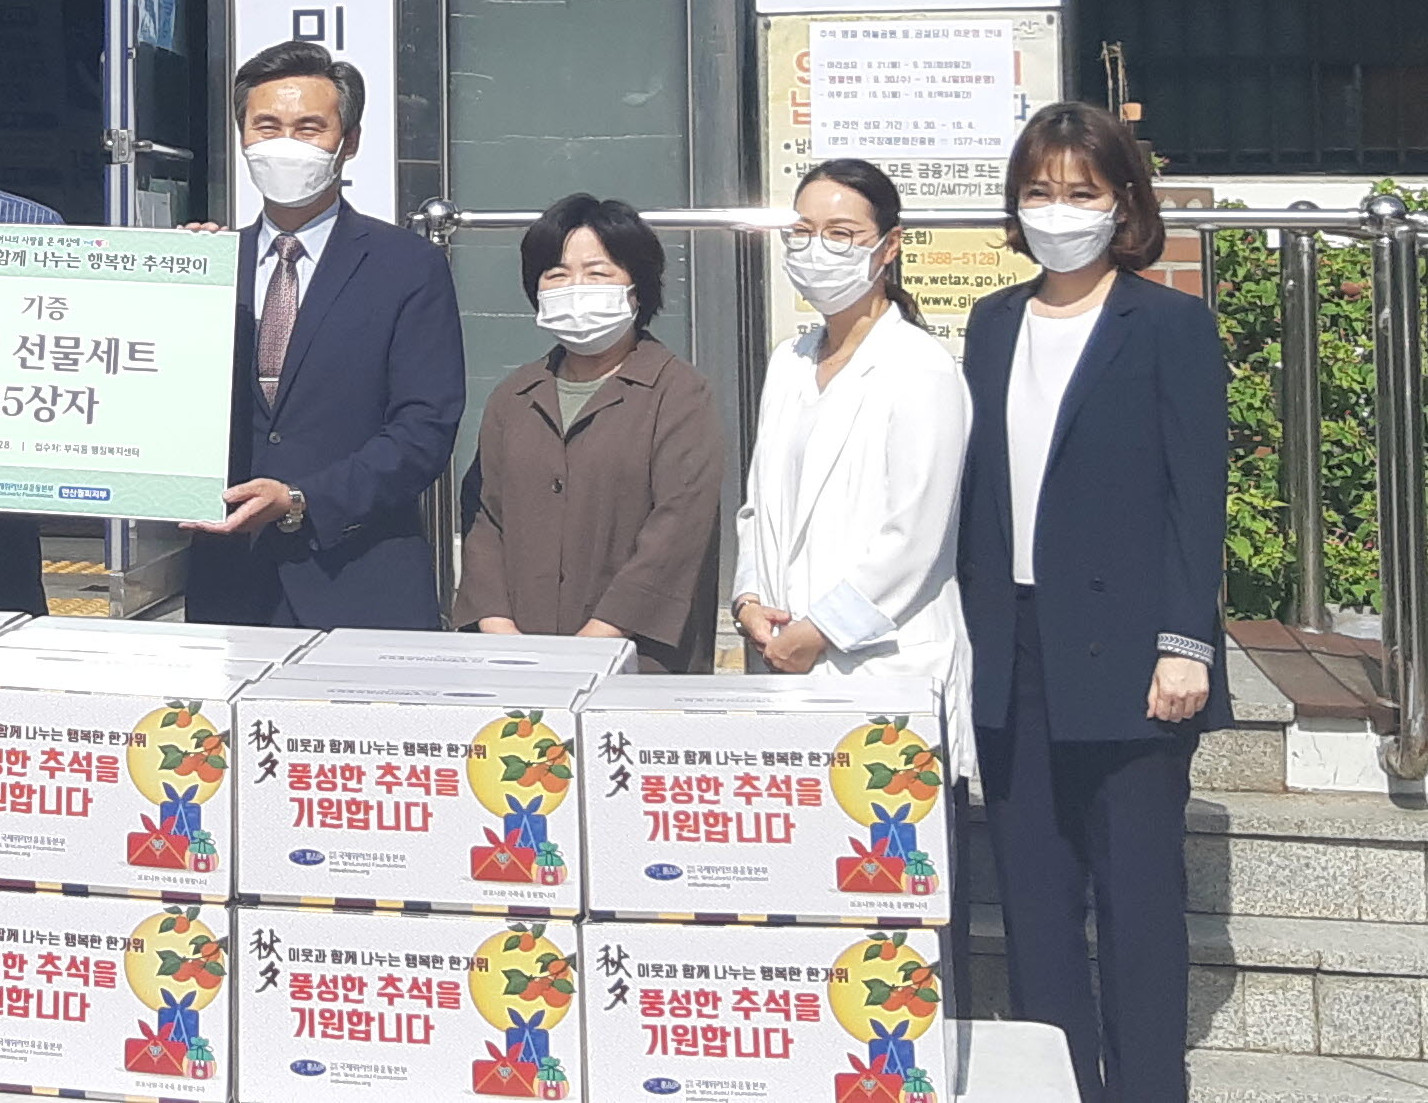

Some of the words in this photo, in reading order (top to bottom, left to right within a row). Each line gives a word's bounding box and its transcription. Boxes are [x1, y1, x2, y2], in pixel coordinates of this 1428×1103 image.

[887, 163, 912, 178] 모든
[917, 163, 969, 178] 금융기관
[974, 163, 1001, 178] 또는
[34, 251, 81, 269] 나누는
[88, 253, 137, 271] 행복한
[142, 254, 208, 274] 추석맞이
[21, 296, 69, 322] 기증
[12, 334, 159, 375] 선물세트
[39, 748, 119, 783] 추석을
[248, 719, 281, 783] 秋夕
[598, 731, 634, 797] 秋夕
[639, 751, 679, 764] 이웃과
[684, 751, 711, 765] 함께
[716, 751, 757, 765] 나누는
[762, 751, 803, 767] 행복한
[808, 751, 850, 767] 한가위
[287, 763, 366, 792] 풍성한
[375, 763, 459, 797] 추석을
[640, 775, 723, 805] 풍성한
[734, 773, 822, 807] 추석을
[290, 797, 433, 832] 기원합니다
[643, 810, 796, 843] 기원합니다
[36, 952, 117, 988] 추석을
[250, 929, 283, 993] 秋夕
[597, 944, 632, 1010] 秋夕
[637, 963, 678, 978] 이웃과
[682, 964, 710, 979] 함께
[715, 965, 755, 981] 나누는
[760, 966, 801, 982] 행복한
[806, 966, 849, 983] 한가위
[289, 973, 367, 1002] 풍성한
[377, 974, 461, 1009] 추석을
[639, 988, 721, 1019] 풍성한
[732, 988, 821, 1022] 추석을
[290, 1007, 434, 1044] 기원합니다
[642, 1024, 793, 1058] 기원합니다
